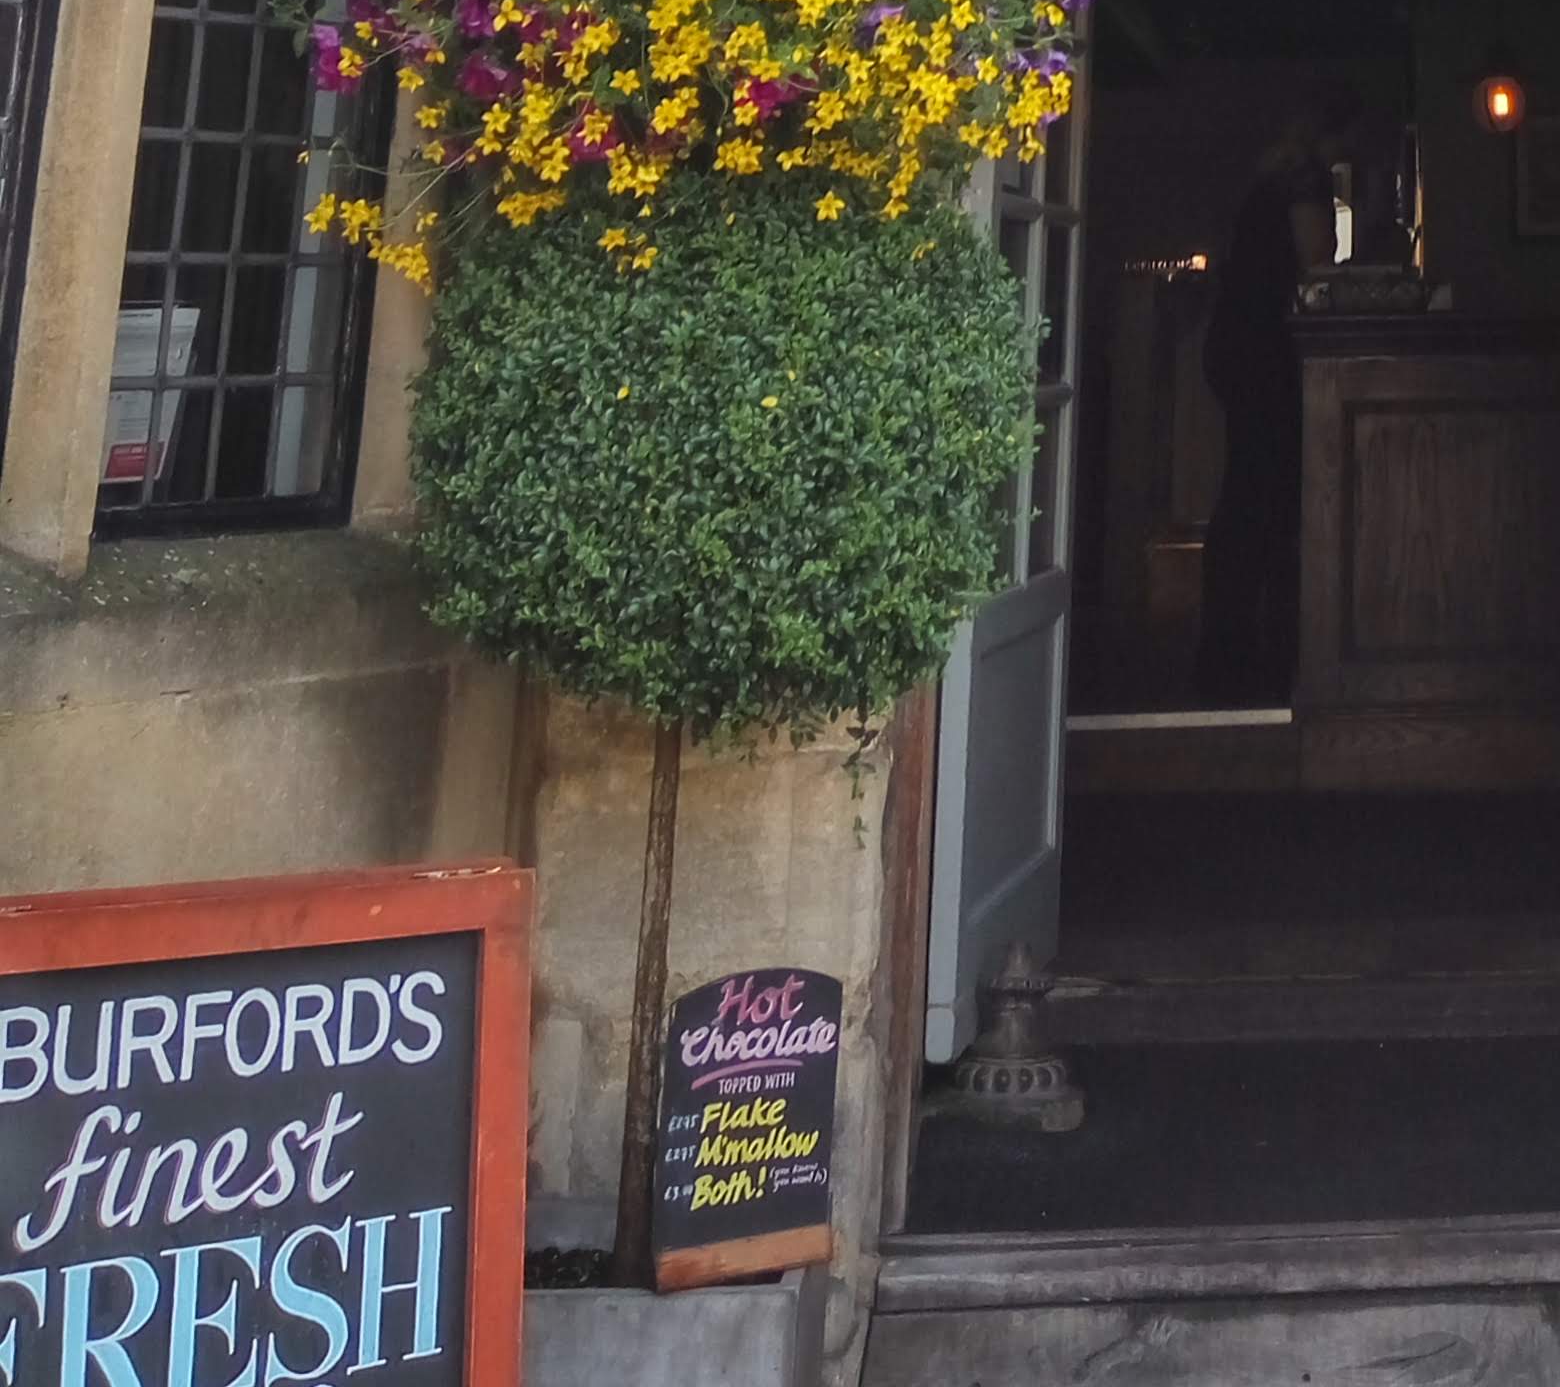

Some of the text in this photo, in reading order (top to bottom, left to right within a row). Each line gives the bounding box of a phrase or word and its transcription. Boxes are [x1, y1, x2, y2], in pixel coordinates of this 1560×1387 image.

[711, 974, 806, 1026] Hot
[0, 970, 446, 1103] BURFORD'S
[679, 1016, 837, 1068] Chocolate
[718, 1071, 796, 1095] TOPPED WITH
[699, 1096, 787, 1134] Flake
[693, 1125, 820, 1169] M'mallow
[13, 1091, 364, 1252] finest
[689, 1166, 768, 1211] Both!
